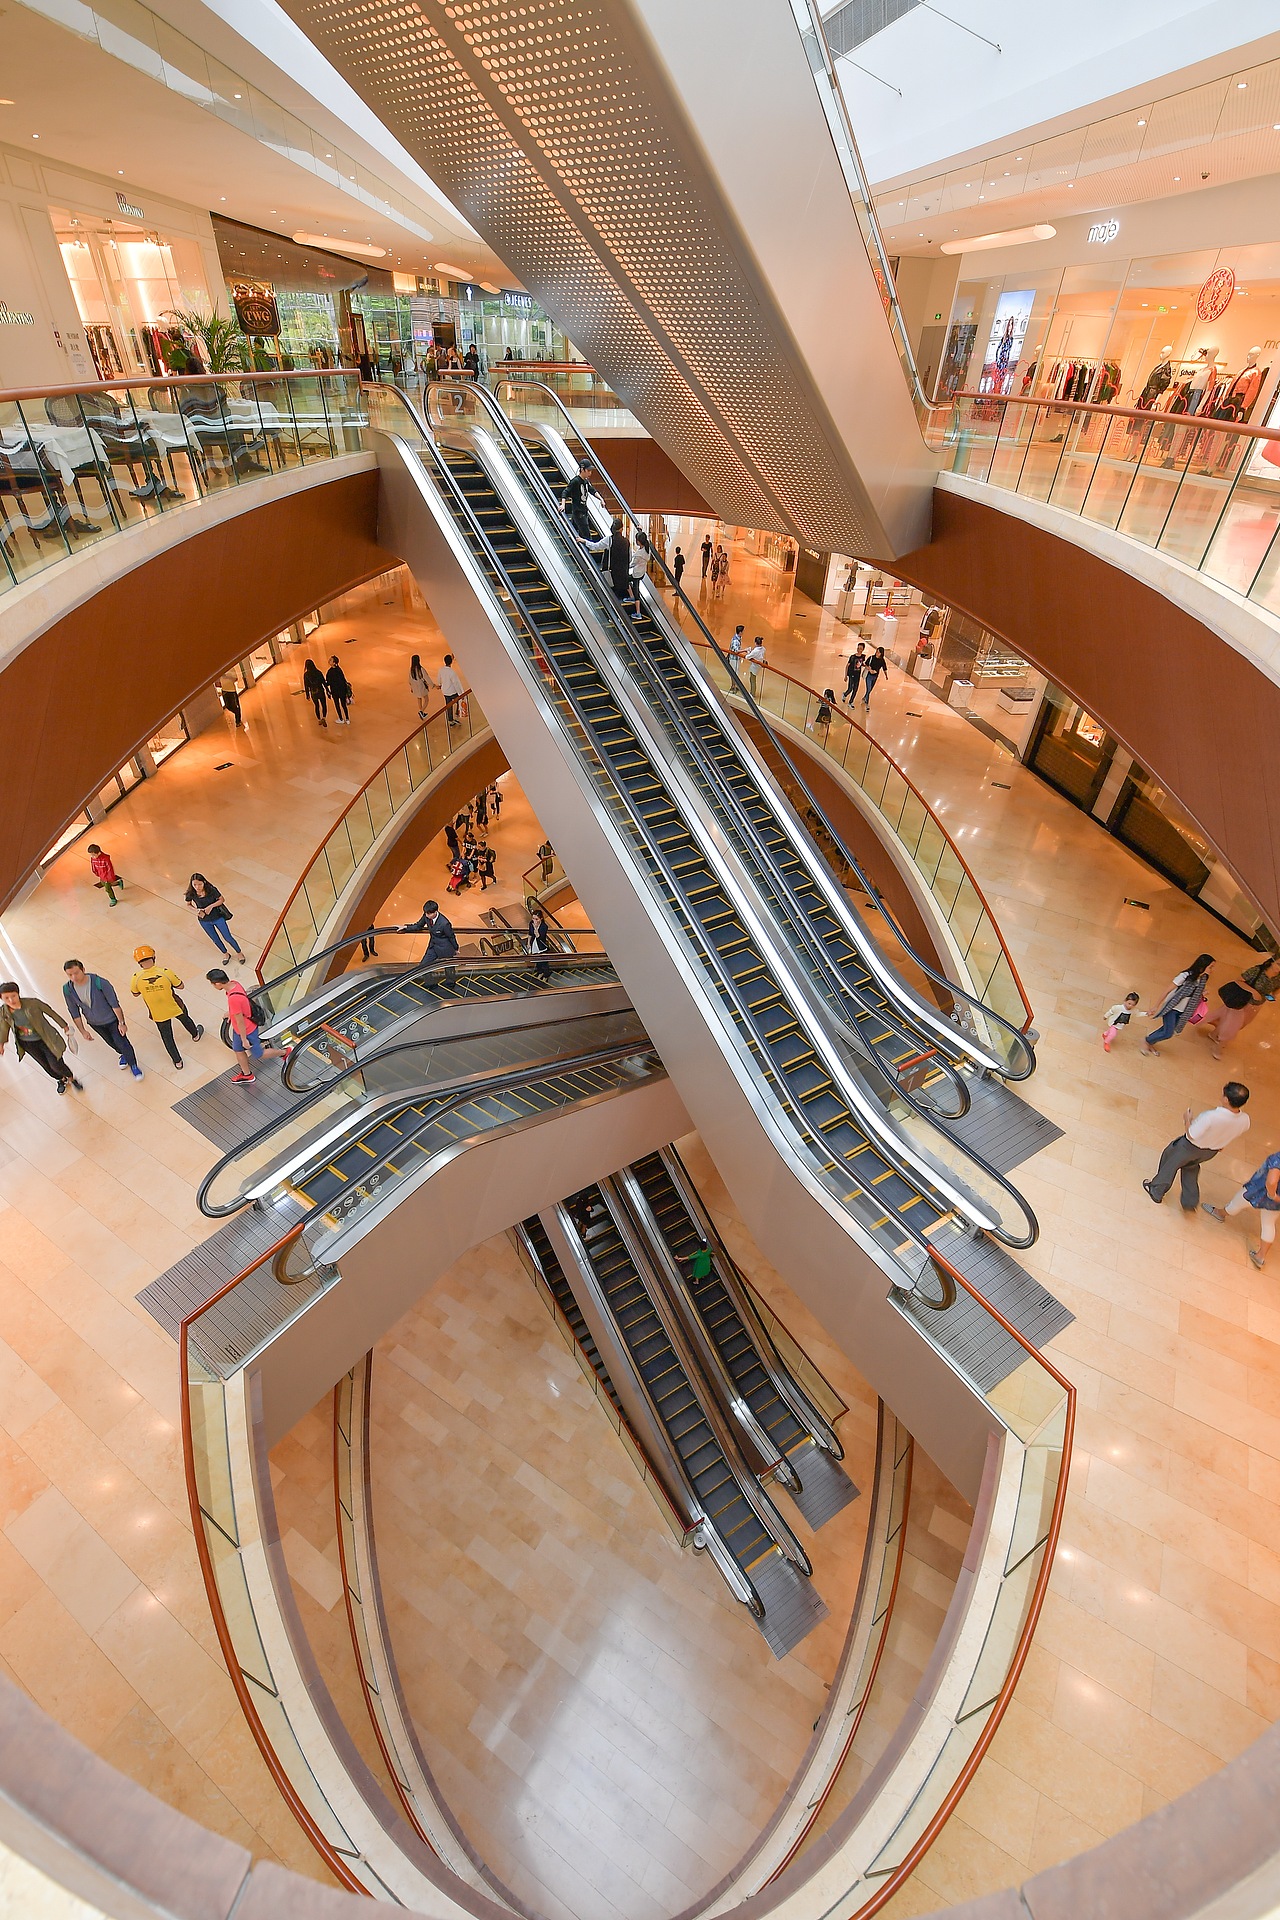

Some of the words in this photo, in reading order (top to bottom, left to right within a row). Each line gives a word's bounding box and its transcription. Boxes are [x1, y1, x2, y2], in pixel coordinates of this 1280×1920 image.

[1086, 218, 1118, 243] maje
[510, 294, 532, 308] JEEVES
[245, 310, 270, 322] TWG
[453, 394, 464, 413] 2
